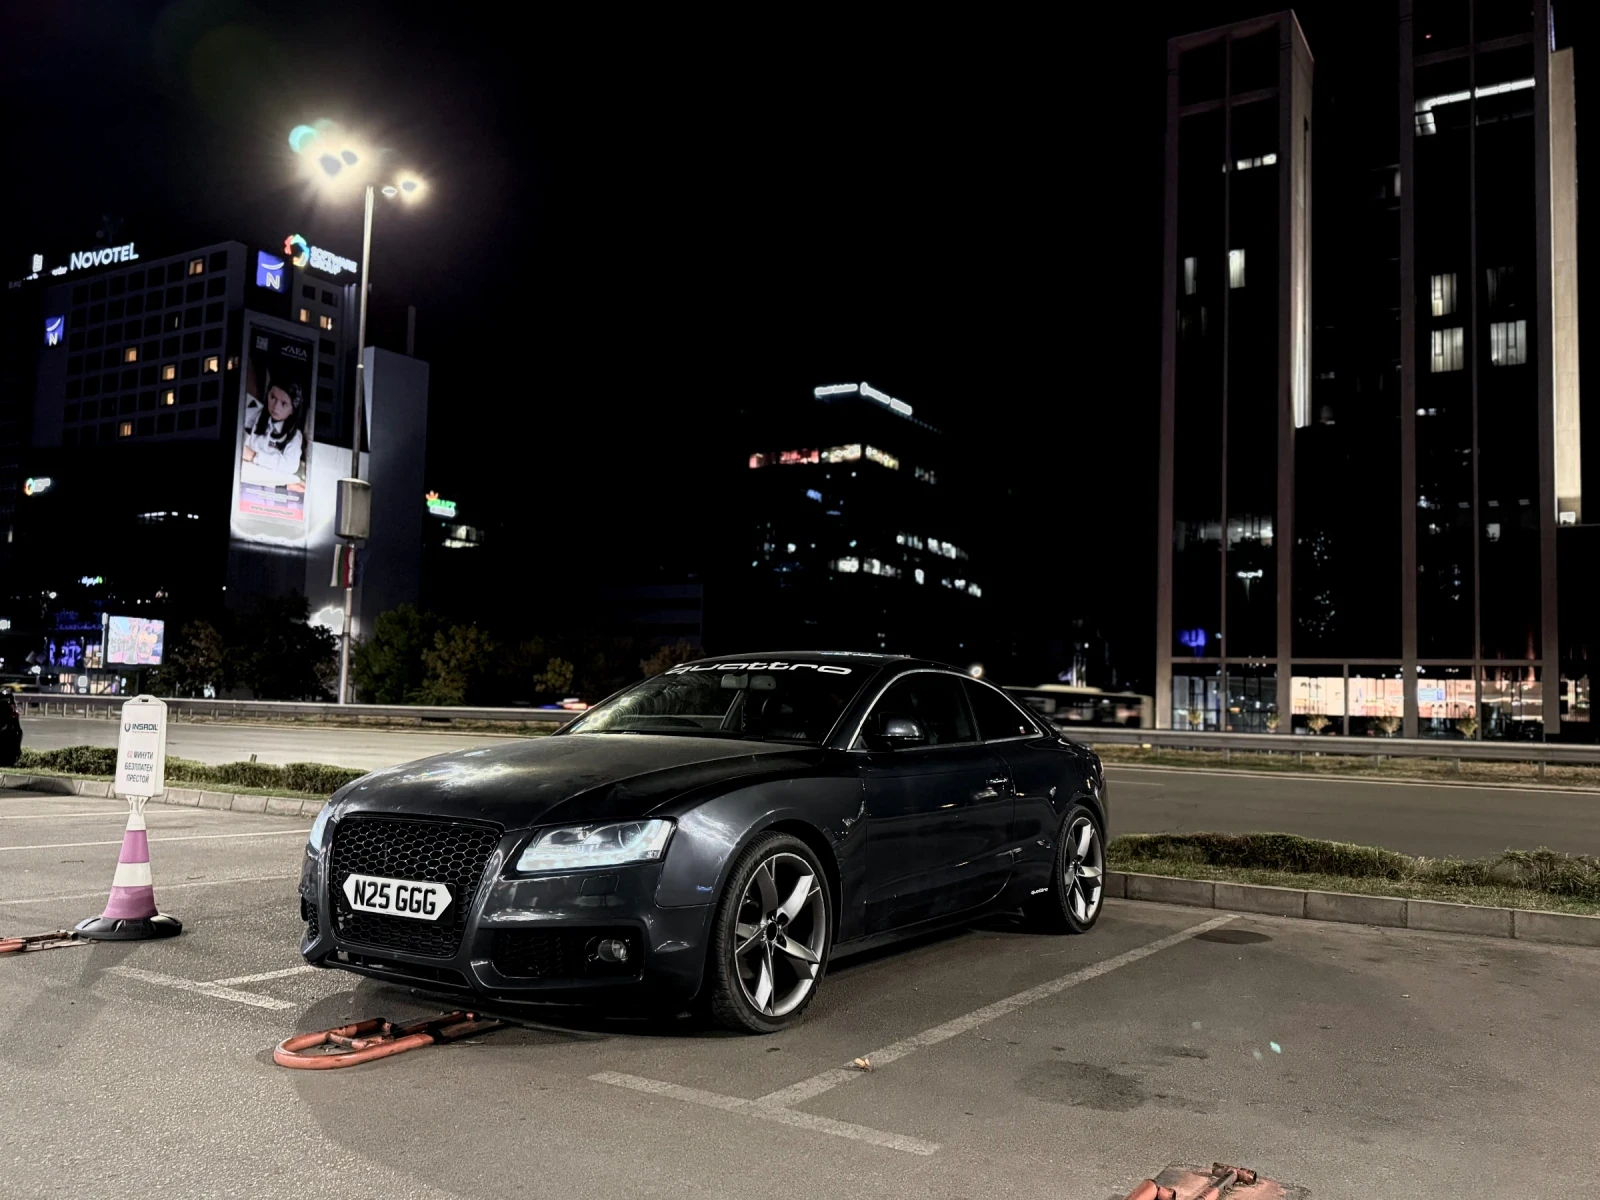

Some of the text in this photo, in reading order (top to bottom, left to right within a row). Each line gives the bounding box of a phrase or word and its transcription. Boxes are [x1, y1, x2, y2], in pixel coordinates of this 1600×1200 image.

[70, 242, 139, 271] NOVOTEL
[265, 272, 281, 290] N
[353, 879, 437, 915] N25 GGG
